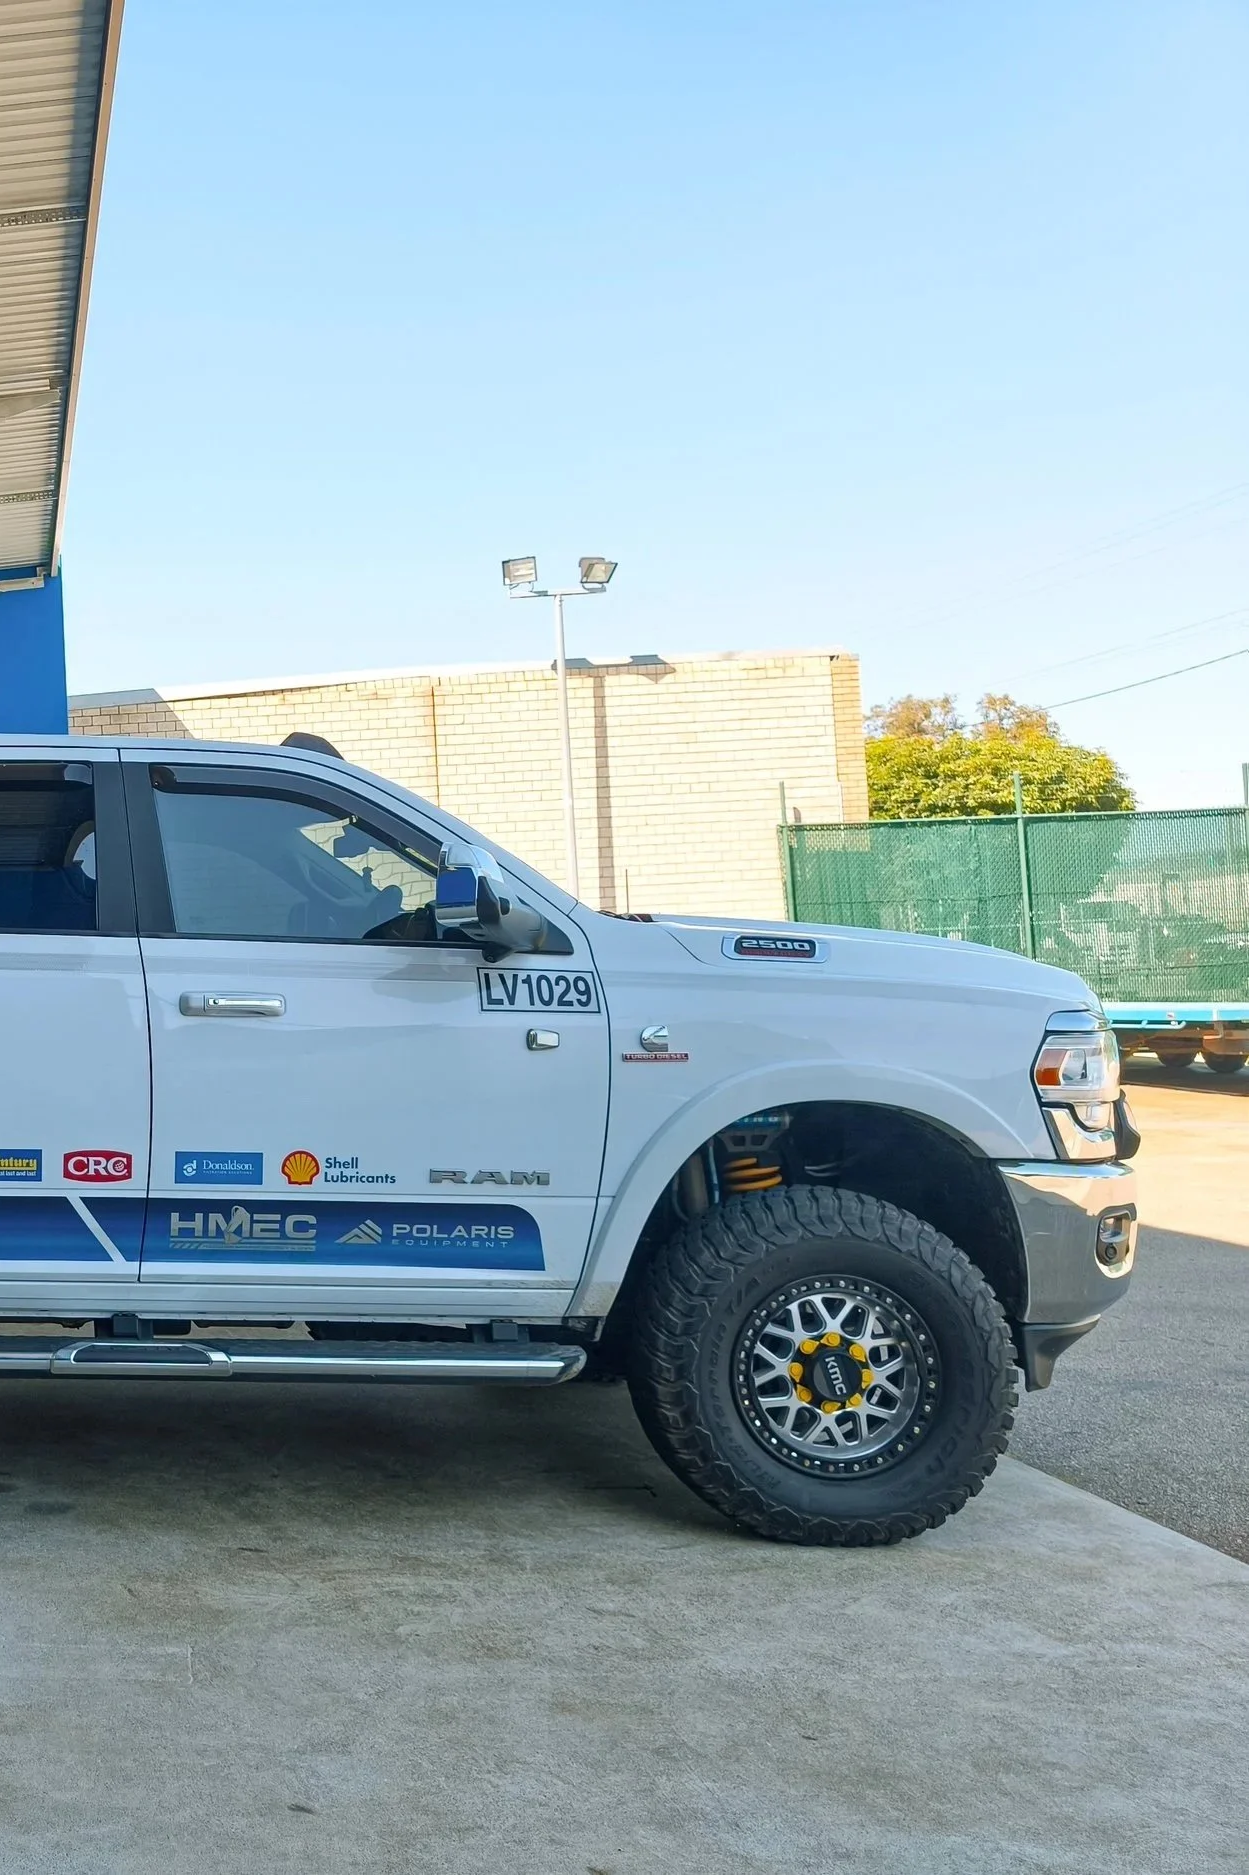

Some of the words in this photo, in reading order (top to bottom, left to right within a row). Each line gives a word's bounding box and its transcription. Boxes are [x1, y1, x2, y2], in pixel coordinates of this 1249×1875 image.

[741, 940, 811, 951] 2500
[483, 973, 592, 1007] LV1029
[67, 1156, 128, 1175] CRC
[325, 1157, 359, 1169] Shell
[324, 1171, 397, 1184] Lubricants
[429, 1168, 551, 1186] RAM
[170, 1207, 317, 1241] HMEC
[392, 1223, 515, 1239] POLARIS
[392, 1239, 509, 1248] EQUIPMENT
